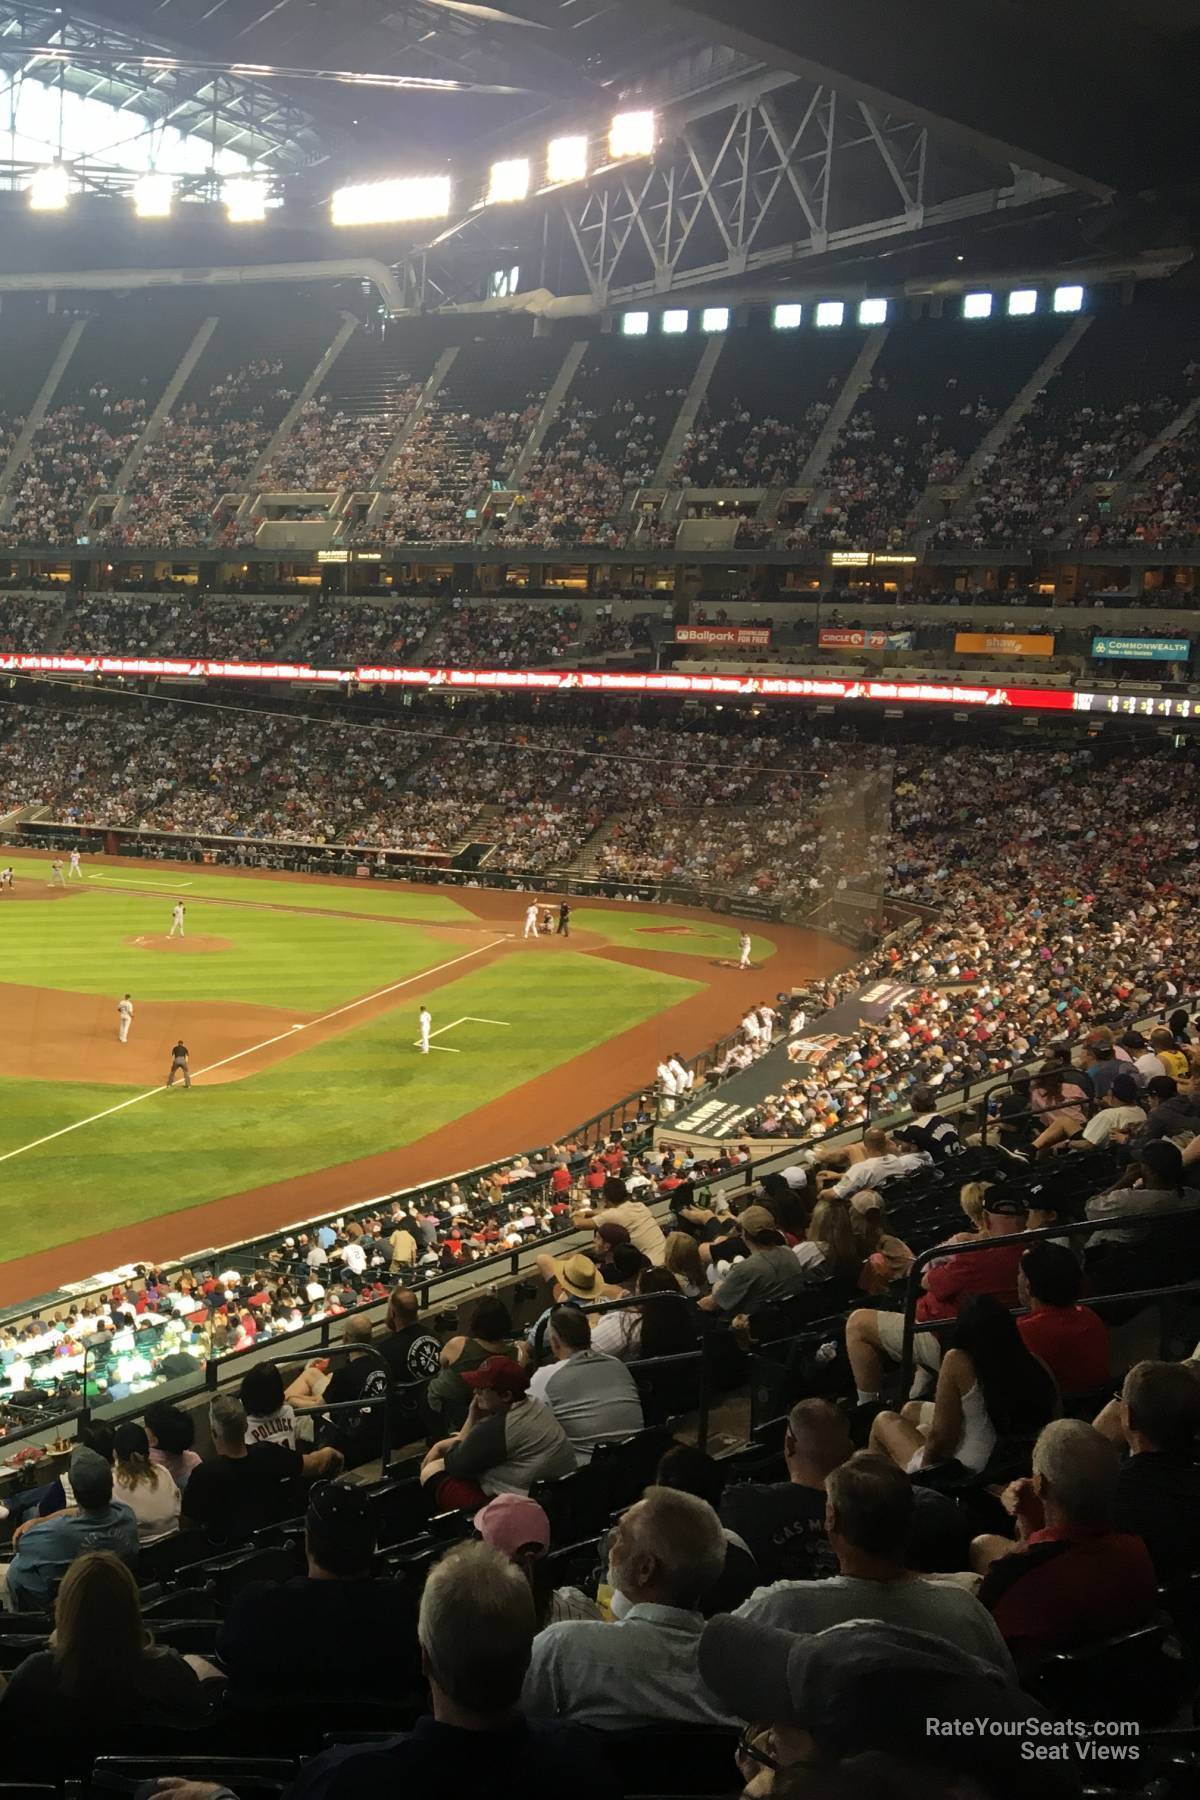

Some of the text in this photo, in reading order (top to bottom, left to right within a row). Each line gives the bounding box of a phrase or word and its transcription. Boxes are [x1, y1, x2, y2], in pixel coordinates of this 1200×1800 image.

[690, 630, 734, 642] Ballpark
[986, 637, 1016, 648] shaw
[251, 1418, 294, 1442] POLLOCK
